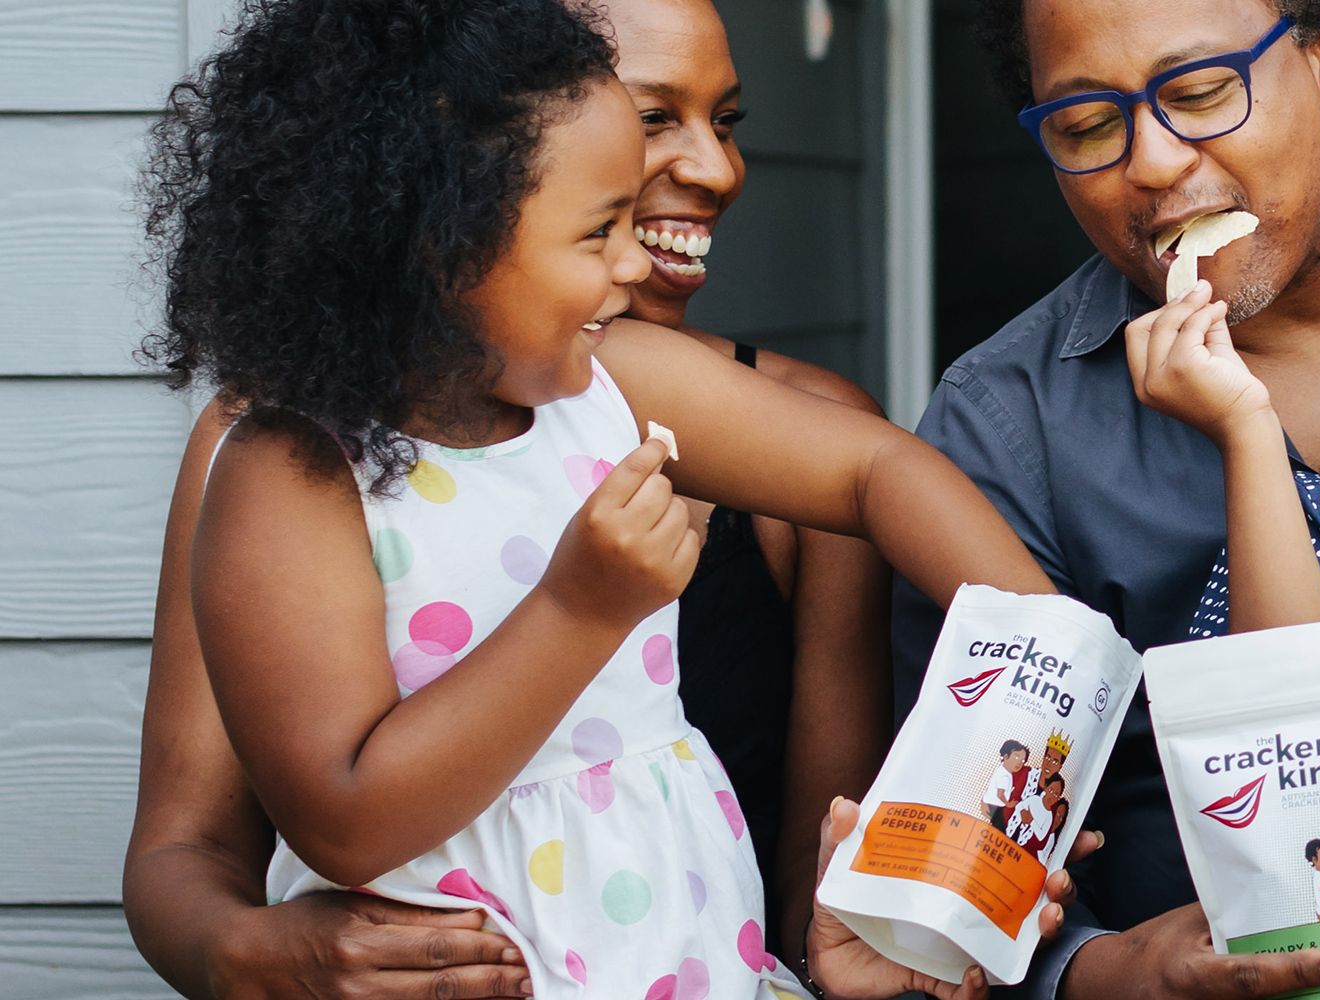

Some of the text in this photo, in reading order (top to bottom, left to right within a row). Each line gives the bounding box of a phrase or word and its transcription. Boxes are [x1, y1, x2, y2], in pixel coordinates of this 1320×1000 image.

[1012, 634, 1029, 643] the
[968, 636, 1073, 679] cracker
[1006, 691, 1043, 709] ARTISAN
[1010, 665, 1076, 718] king
[1003, 698, 1048, 720] CRACKERS
[1256, 736, 1275, 747] the
[1281, 790, 1320, 803] ARTISAN
[886, 807, 944, 823] CHEDDAR
[881, 817, 928, 832] PEPPER
[974, 839, 1005, 864] FREE
[980, 828, 1022, 863] GLUTEN
